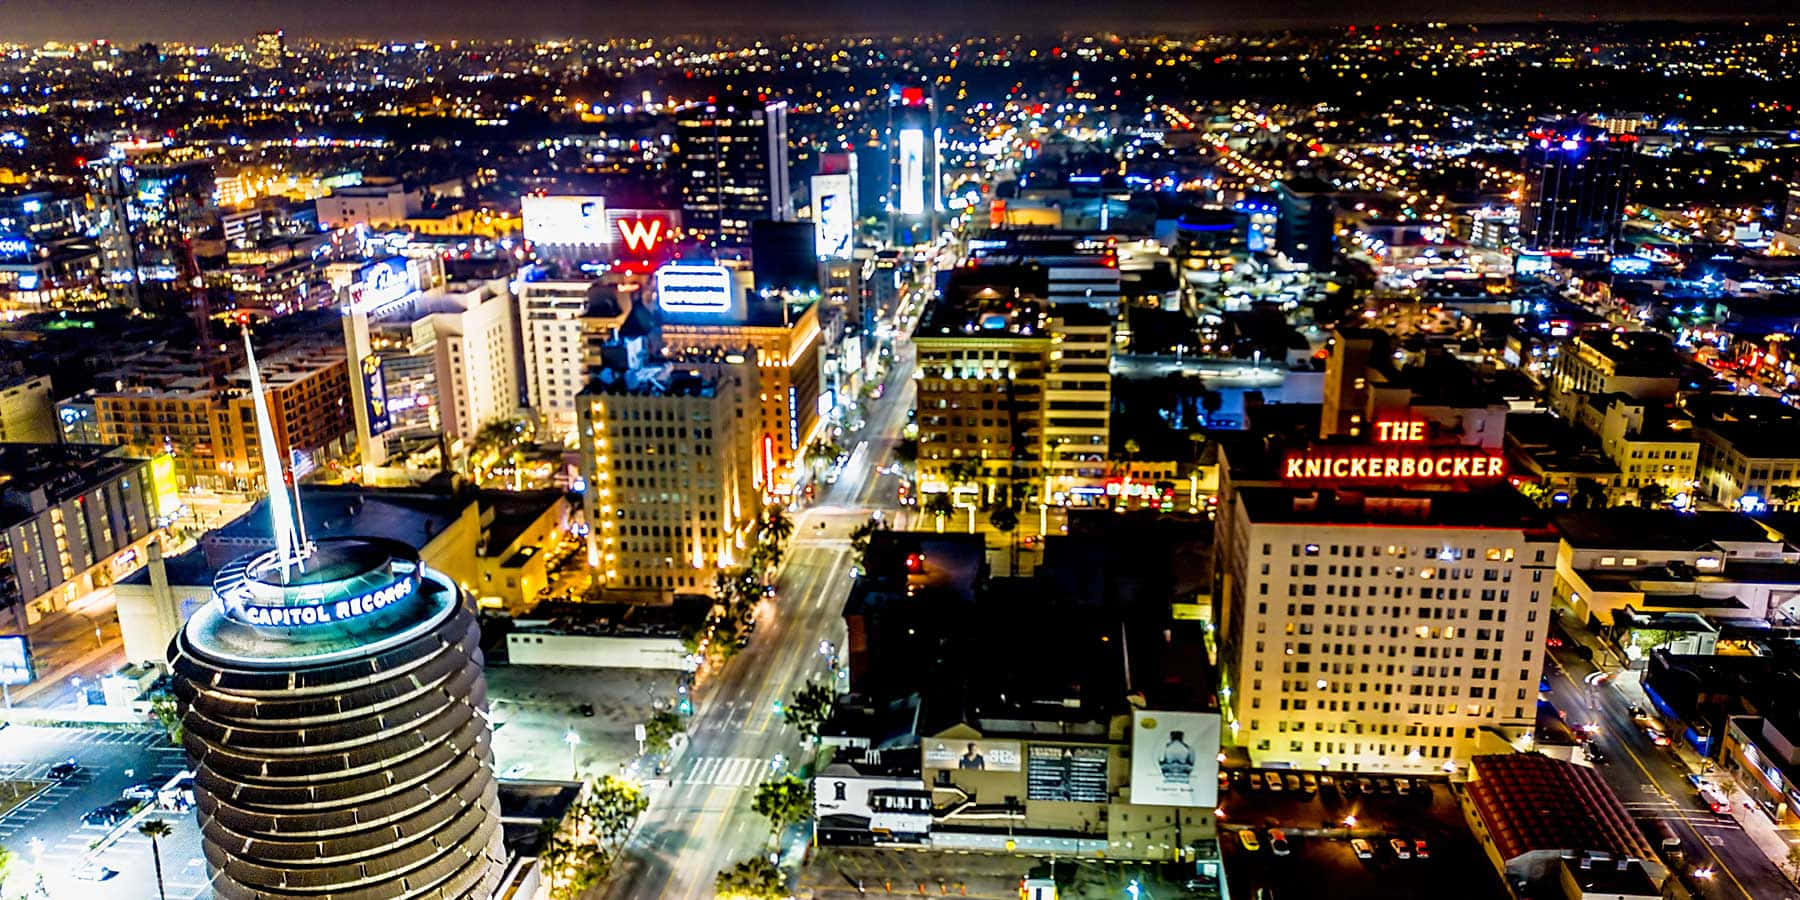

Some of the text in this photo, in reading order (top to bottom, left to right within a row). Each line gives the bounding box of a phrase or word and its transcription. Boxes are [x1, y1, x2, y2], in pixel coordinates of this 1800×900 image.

[617, 219, 661, 251] W
[1378, 422, 1424, 441] THE
[1287, 458, 1503, 478] KNICKERBOCKER
[247, 577, 412, 625] CAPITOL RECORDS
